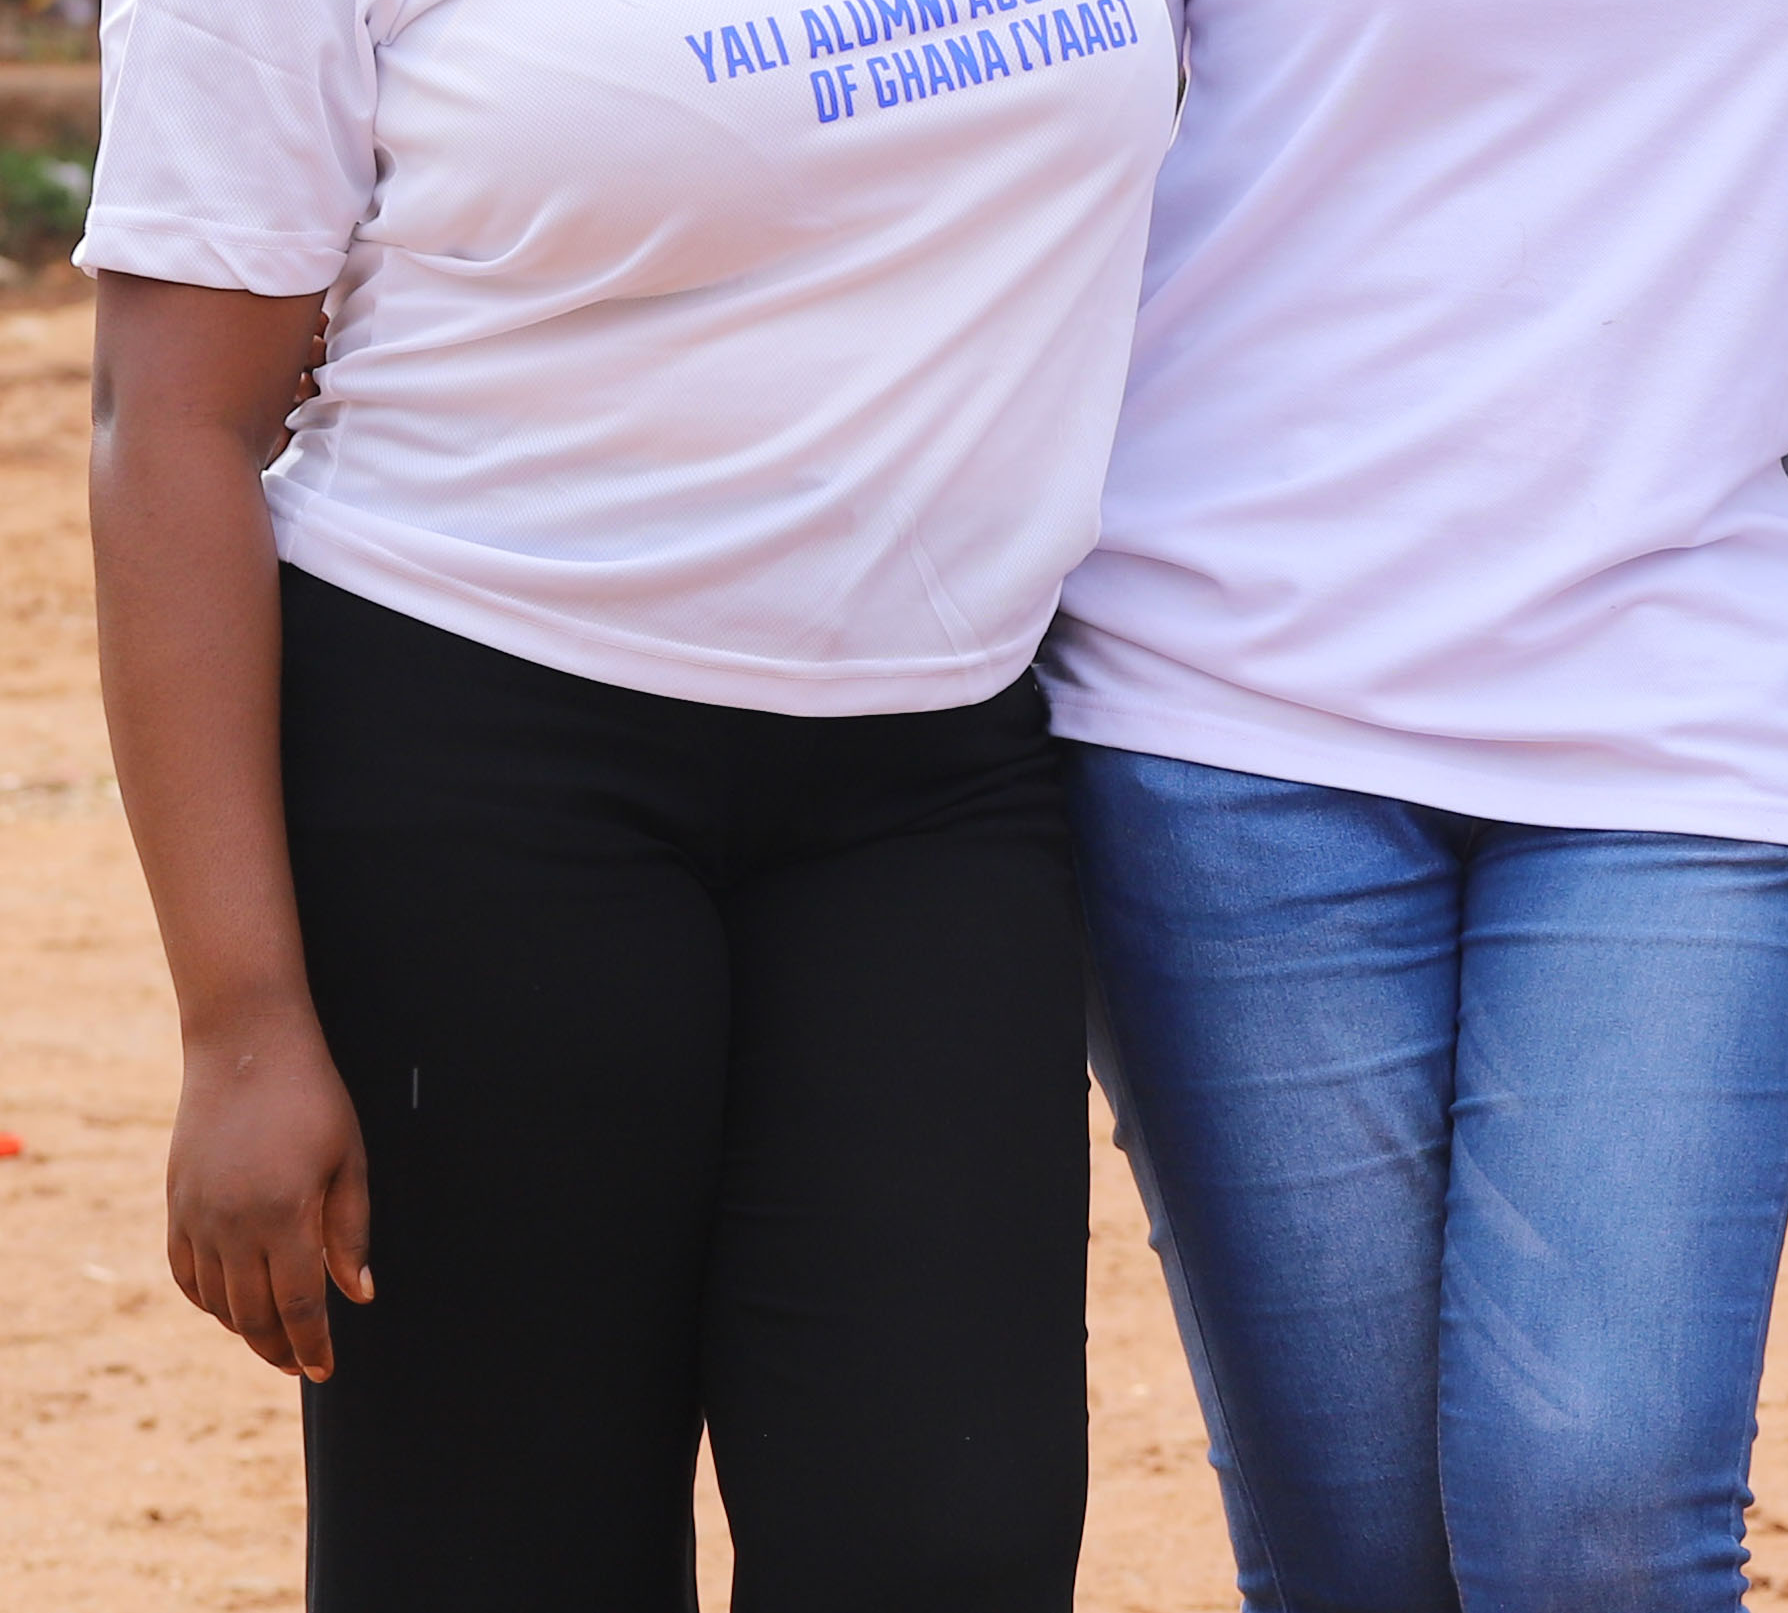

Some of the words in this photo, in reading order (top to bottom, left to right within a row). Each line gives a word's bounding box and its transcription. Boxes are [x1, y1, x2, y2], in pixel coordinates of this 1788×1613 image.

[685, 16, 790, 83] YALI
[809, 63, 858, 124] OF
[867, 28, 1011, 109] GHANA
